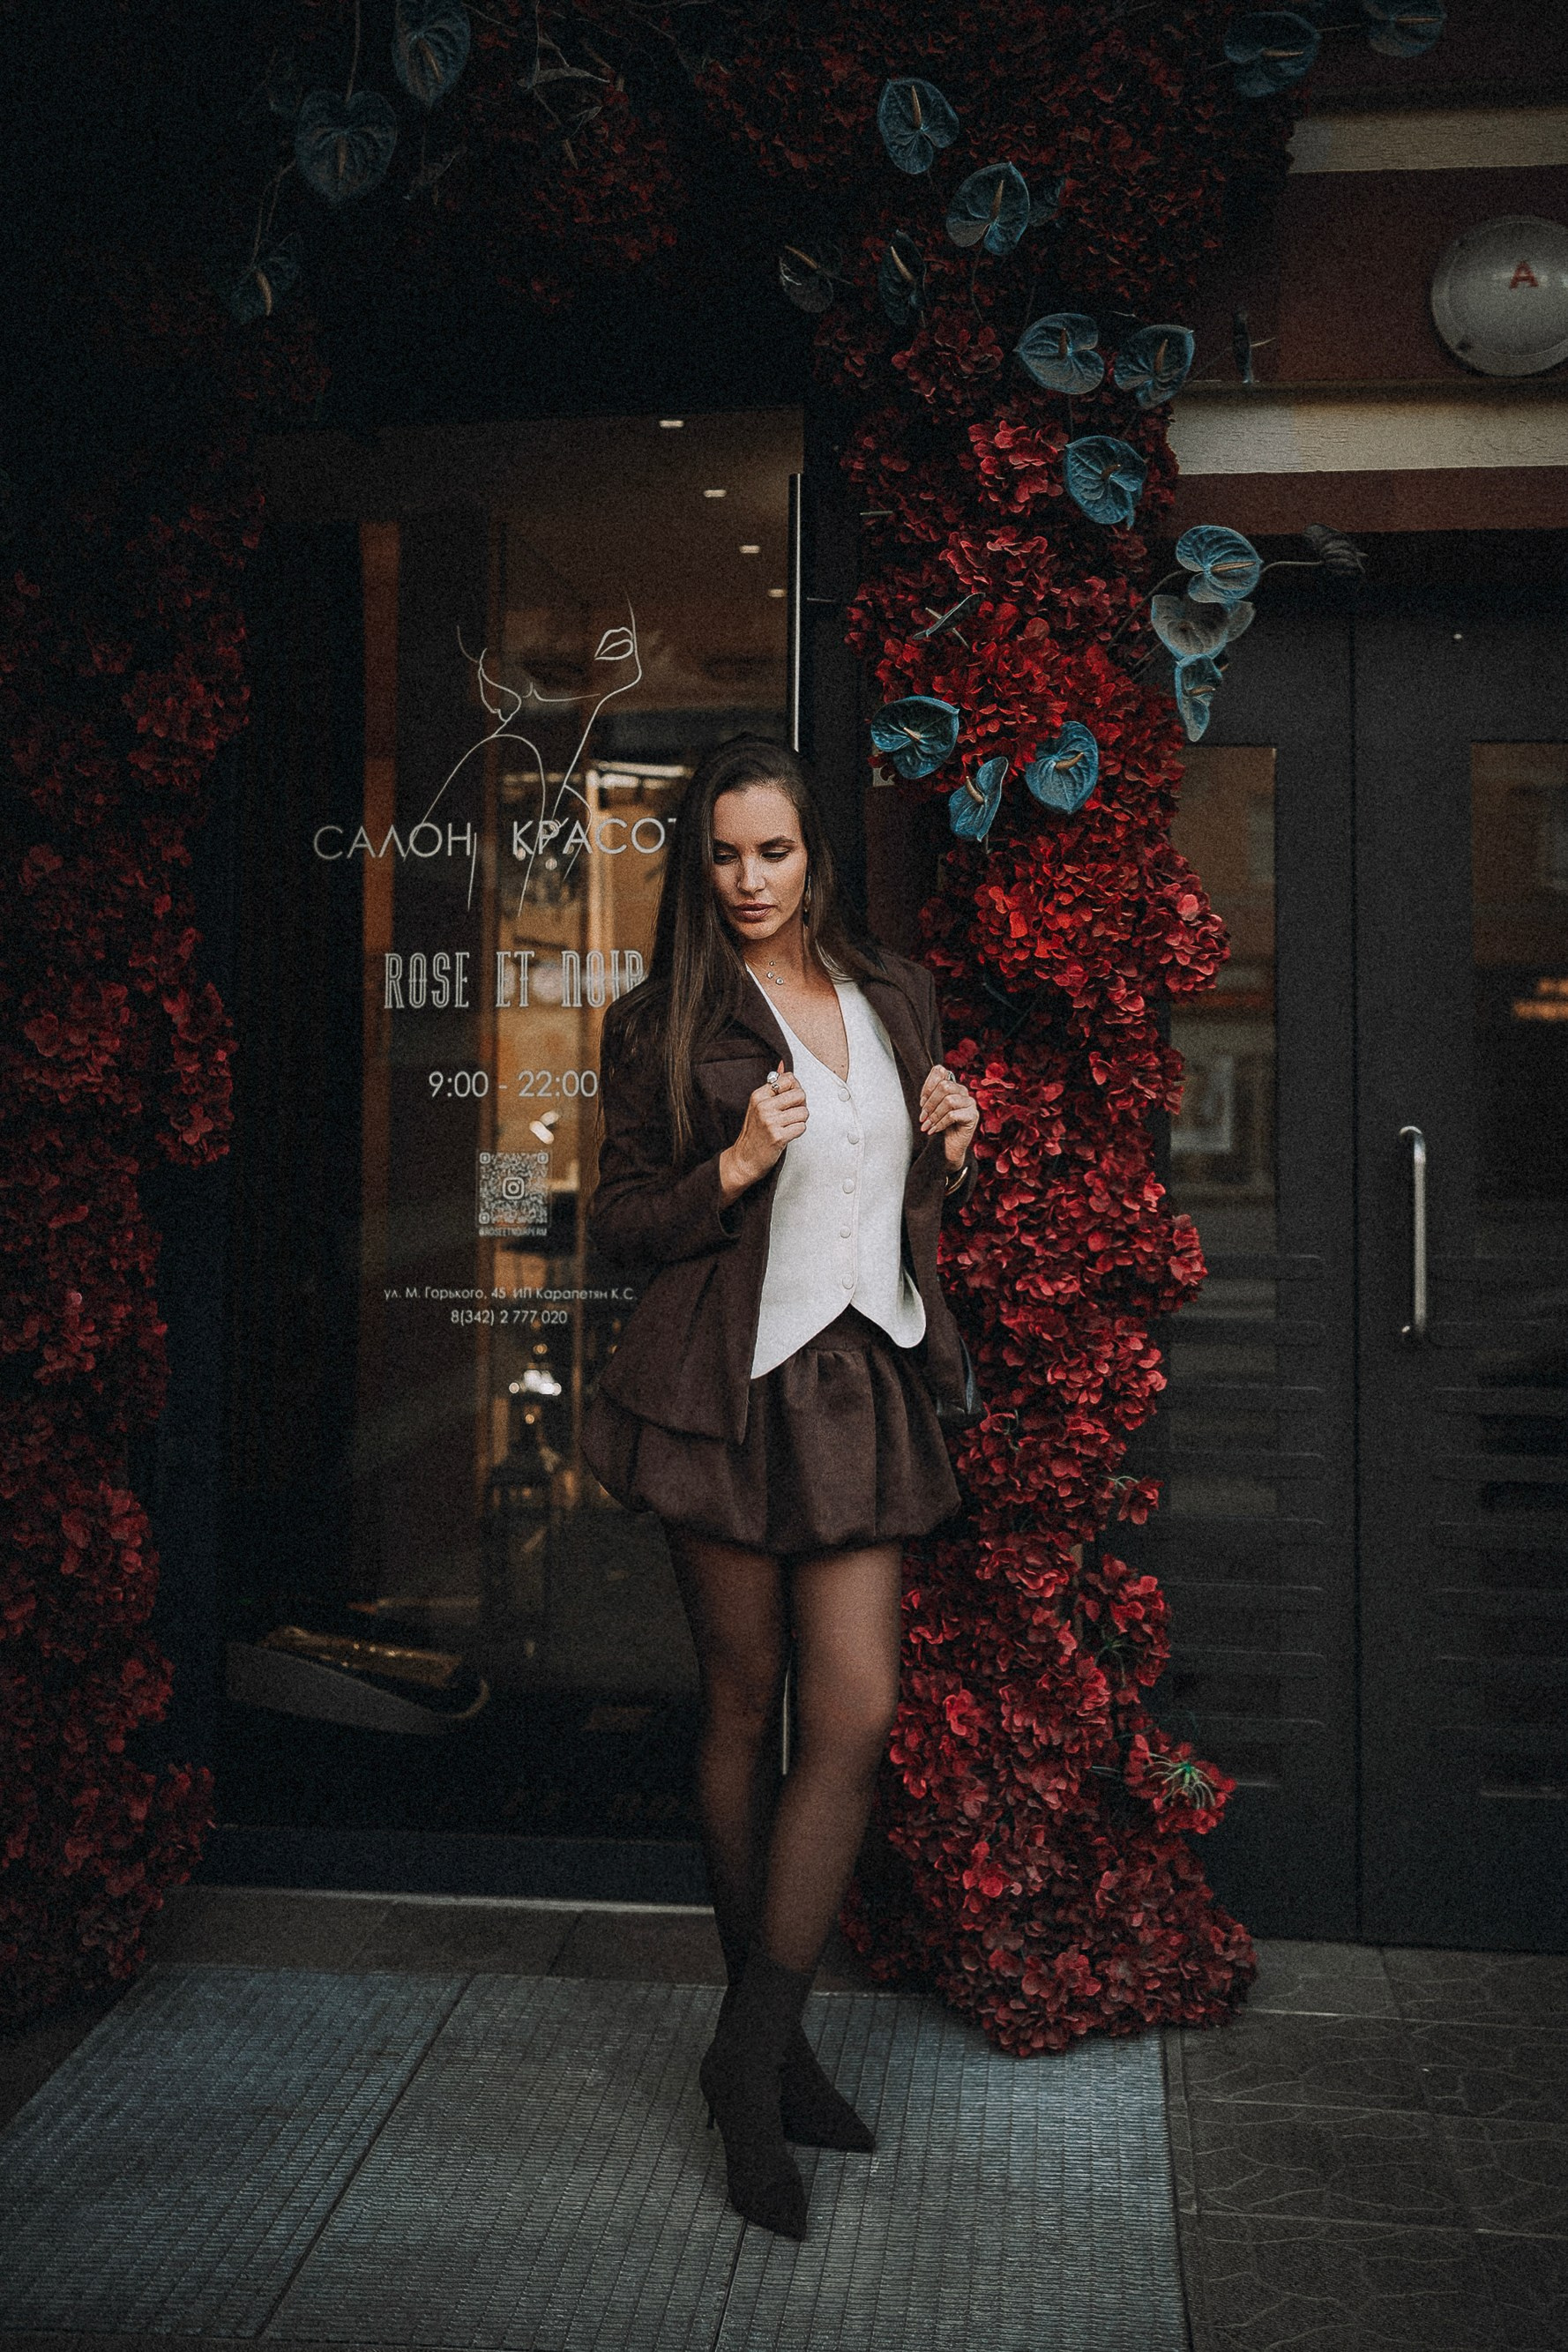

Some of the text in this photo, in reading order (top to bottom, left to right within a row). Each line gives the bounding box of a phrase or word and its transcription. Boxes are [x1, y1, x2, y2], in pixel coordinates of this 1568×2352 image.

[1508, 259, 1540, 289] A
[313, 818, 677, 861] САЛОН КРАСО
[385, 949, 649, 1009] ROSE ET NOIR
[428, 1070, 489, 1098] 9:00
[518, 1069, 599, 1098] 22:00
[384, 1288, 402, 1301] ул.
[406, 1287, 422, 1299] М.
[491, 1287, 506, 1299] 45
[512, 1287, 532, 1299] ИП
[535, 1287, 609, 1302] Карапетян
[451, 1309, 568, 1326] 8(342) 2 777 020
